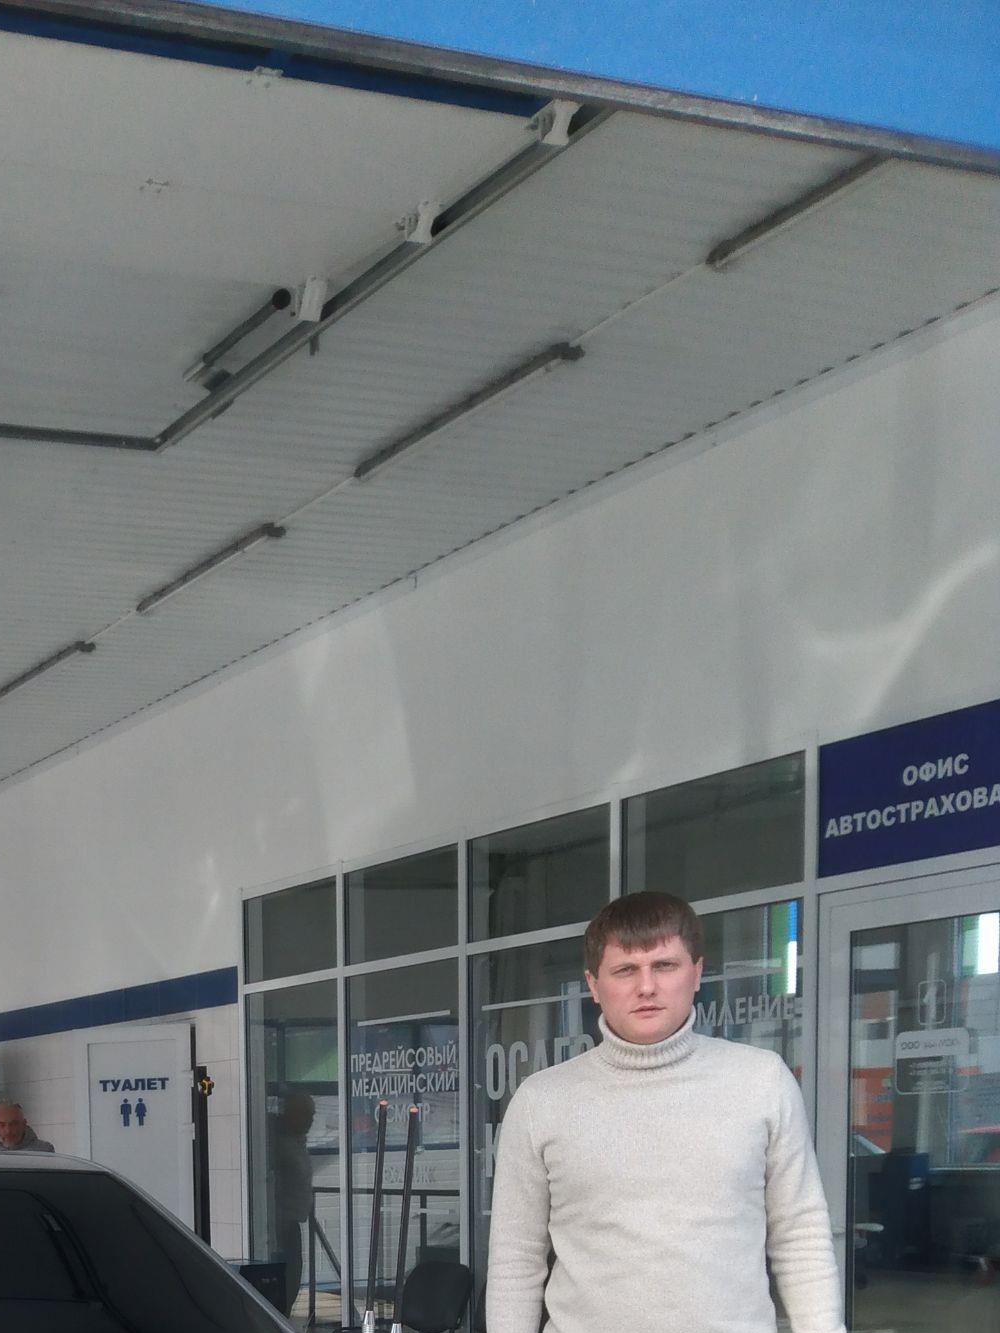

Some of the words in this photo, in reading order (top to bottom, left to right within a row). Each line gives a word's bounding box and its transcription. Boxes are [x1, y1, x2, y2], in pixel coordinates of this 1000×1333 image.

[902, 753, 970, 787] ОФИС
[824, 783, 1000, 839] АВТОСТРАХОВА
[350, 1040, 457, 1074] ПРЕДРЕЙСОВЫЙ
[99, 1077, 169, 1093] ТУАЛЕТ
[352, 1069, 457, 1099] МЕДИЦИНСКИЙ
